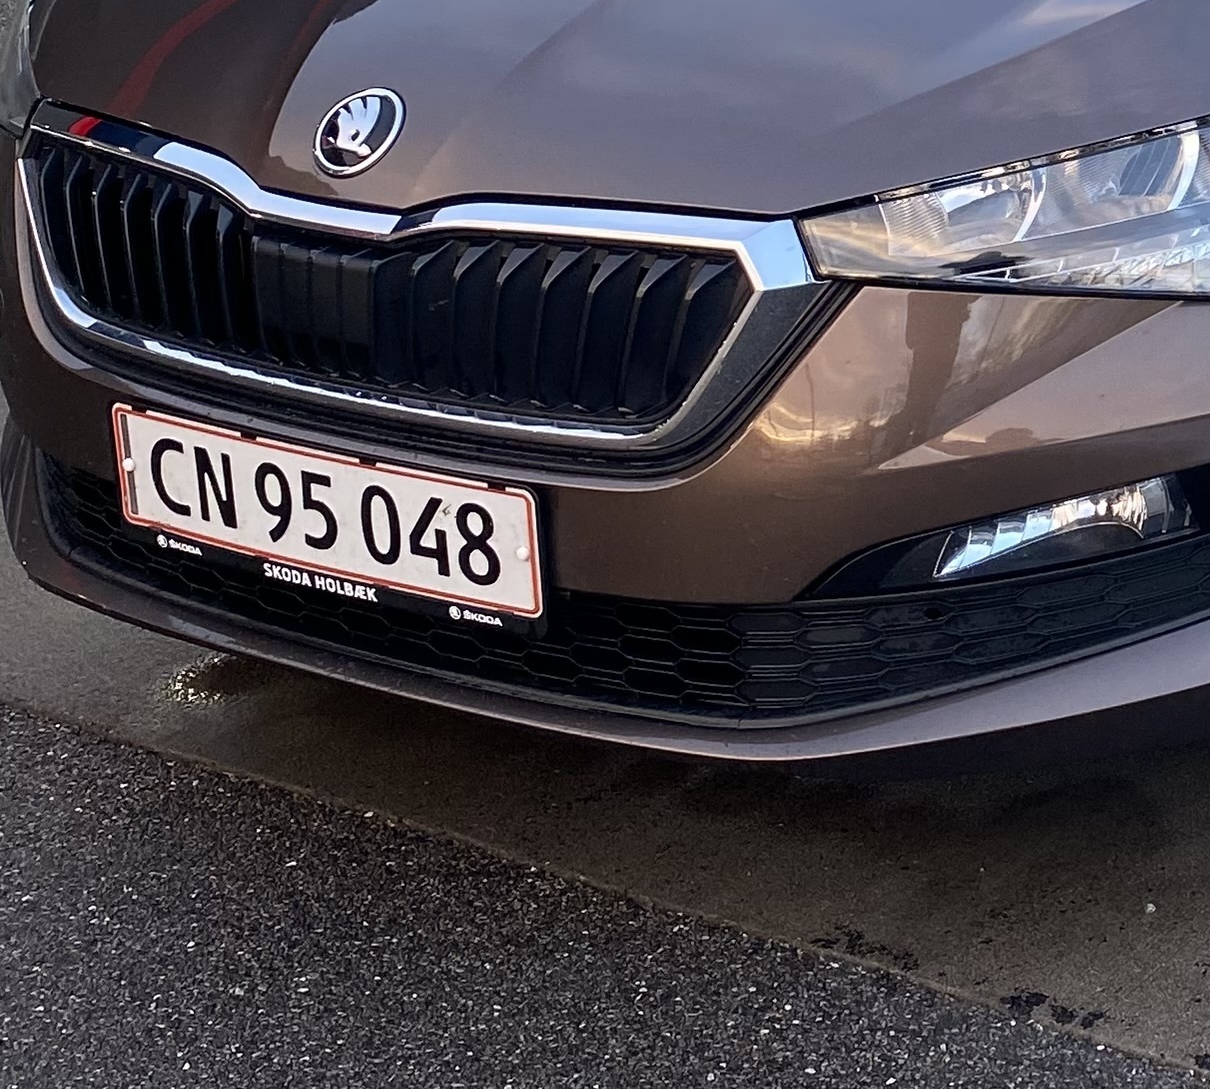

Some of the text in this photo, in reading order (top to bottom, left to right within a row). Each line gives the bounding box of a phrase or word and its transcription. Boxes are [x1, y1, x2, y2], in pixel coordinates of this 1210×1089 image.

[150, 438, 501, 586] CN 95 048
[263, 562, 379, 603] SKODA HOLBÆK
